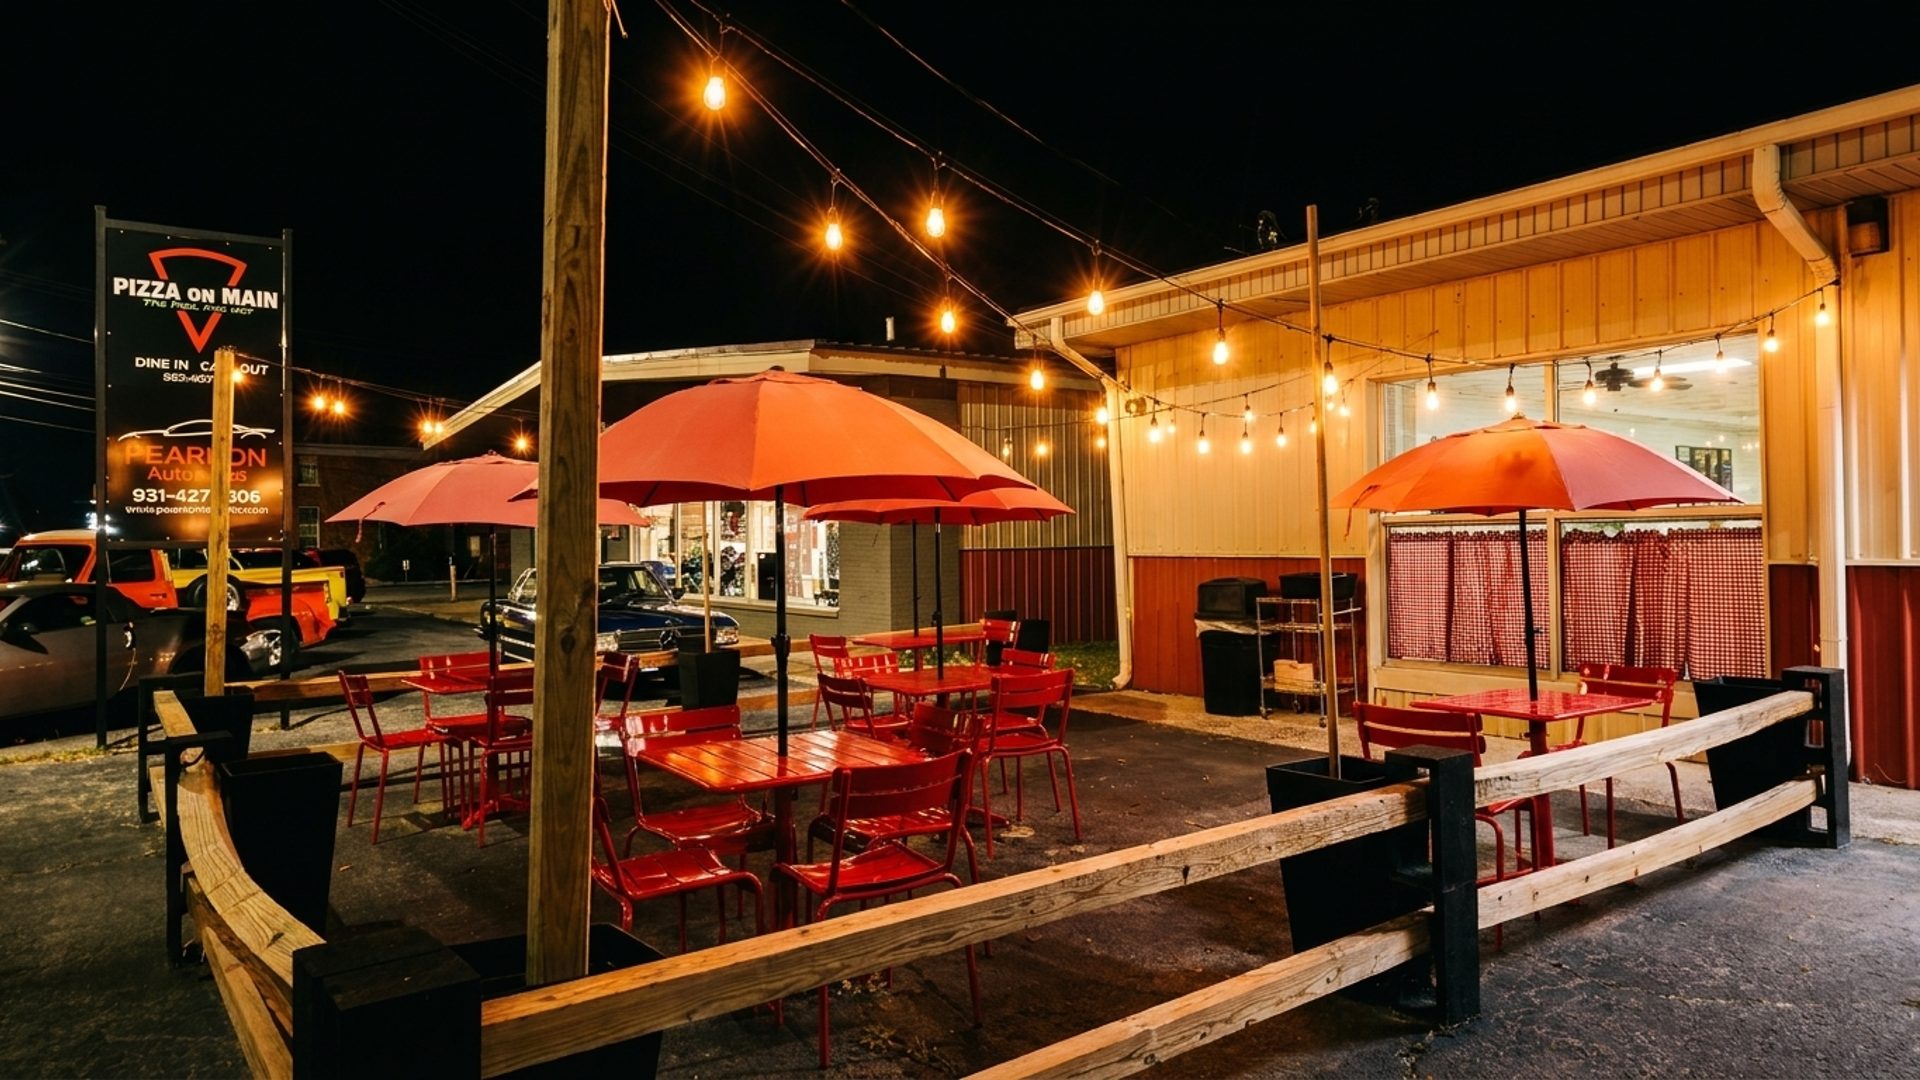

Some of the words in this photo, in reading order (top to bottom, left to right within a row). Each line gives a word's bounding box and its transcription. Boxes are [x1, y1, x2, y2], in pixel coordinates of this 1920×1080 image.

[113, 277, 181, 301] PIZZA
[187, 287, 215, 304] ON
[222, 287, 279, 309] MAIN
[135, 357, 170, 370] DINE
[174, 359, 189, 371] IN
[240, 363, 269, 375] OUT
